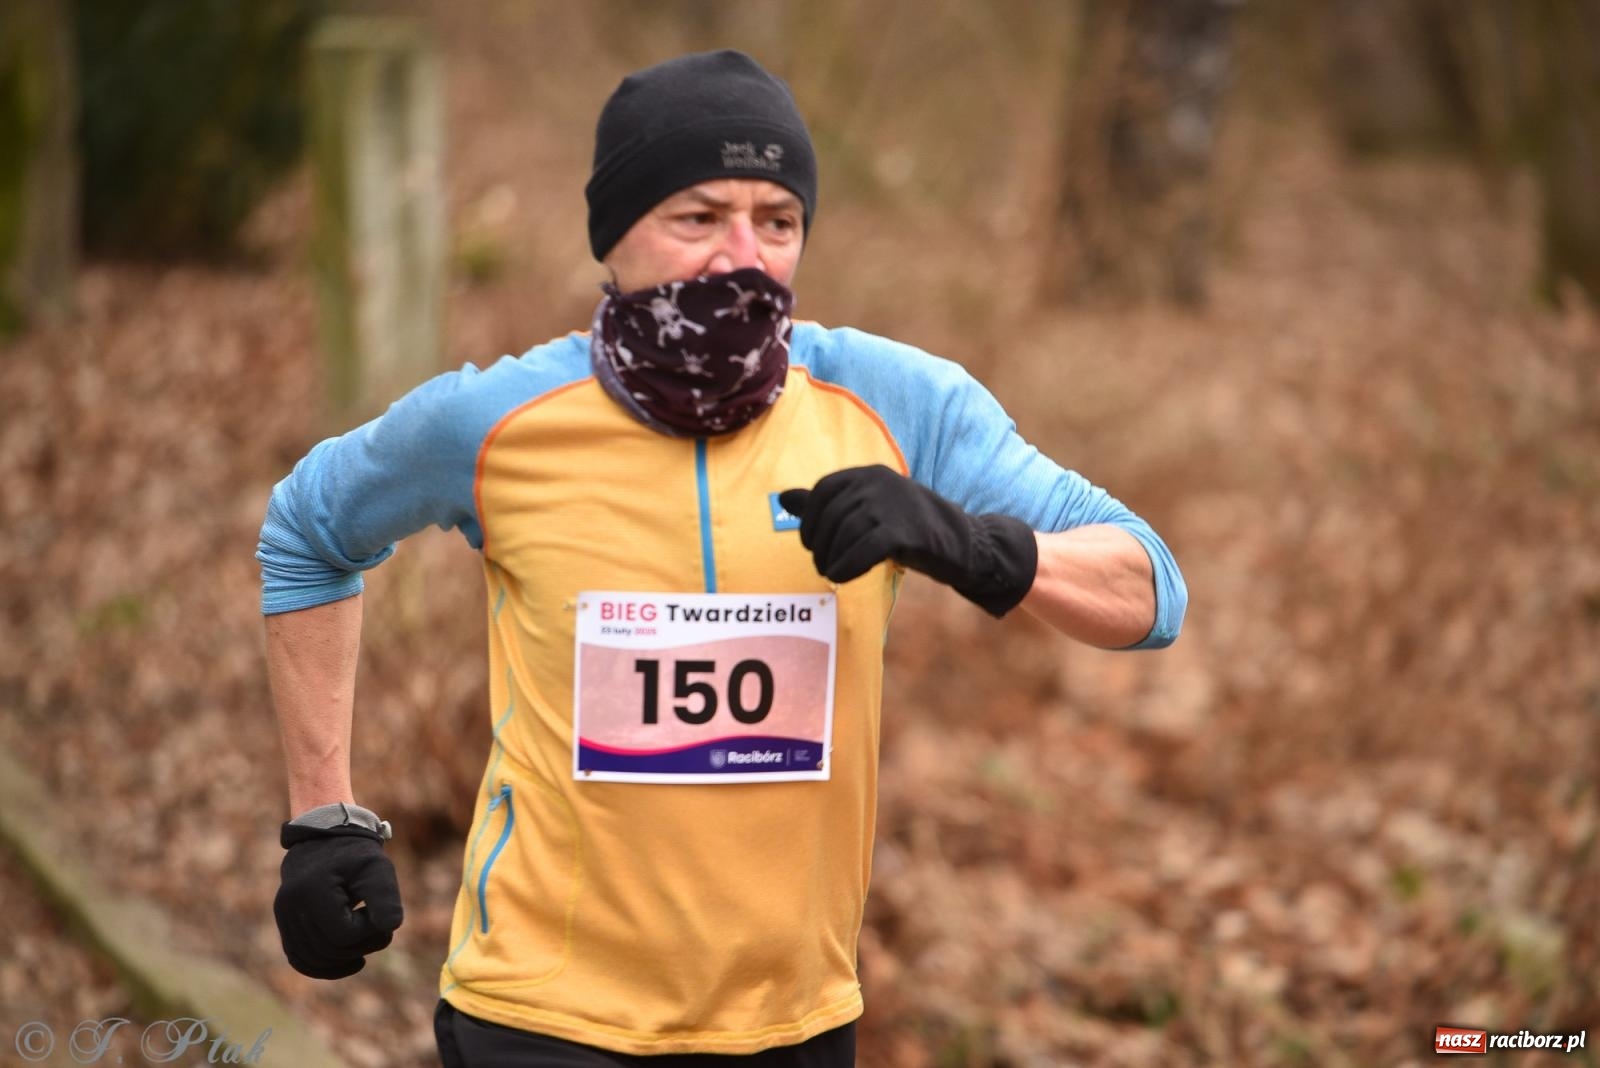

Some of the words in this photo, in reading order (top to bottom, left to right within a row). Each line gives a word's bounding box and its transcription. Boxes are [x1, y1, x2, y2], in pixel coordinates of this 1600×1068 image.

[600, 602, 658, 621] BIEG
[666, 603, 813, 623] Twardziela
[634, 658, 775, 725] 150
